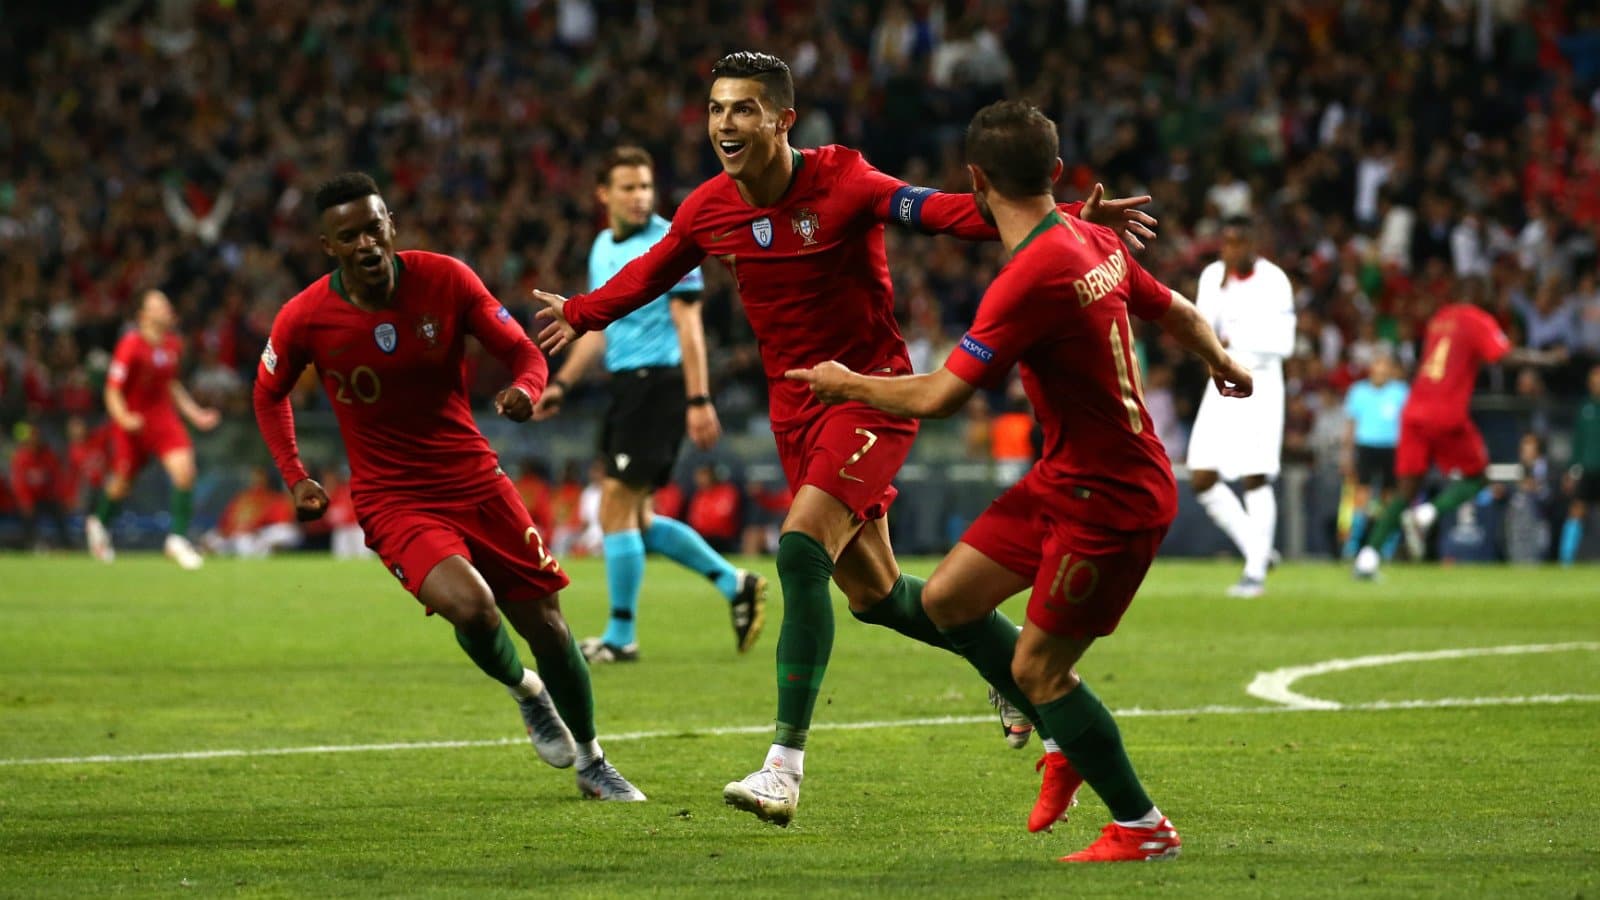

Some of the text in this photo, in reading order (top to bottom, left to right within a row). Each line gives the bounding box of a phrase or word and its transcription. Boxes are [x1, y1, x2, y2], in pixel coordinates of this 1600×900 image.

[325, 366, 381, 404] 20
[846, 428, 878, 464] 7
[1049, 552, 1098, 604] 10
